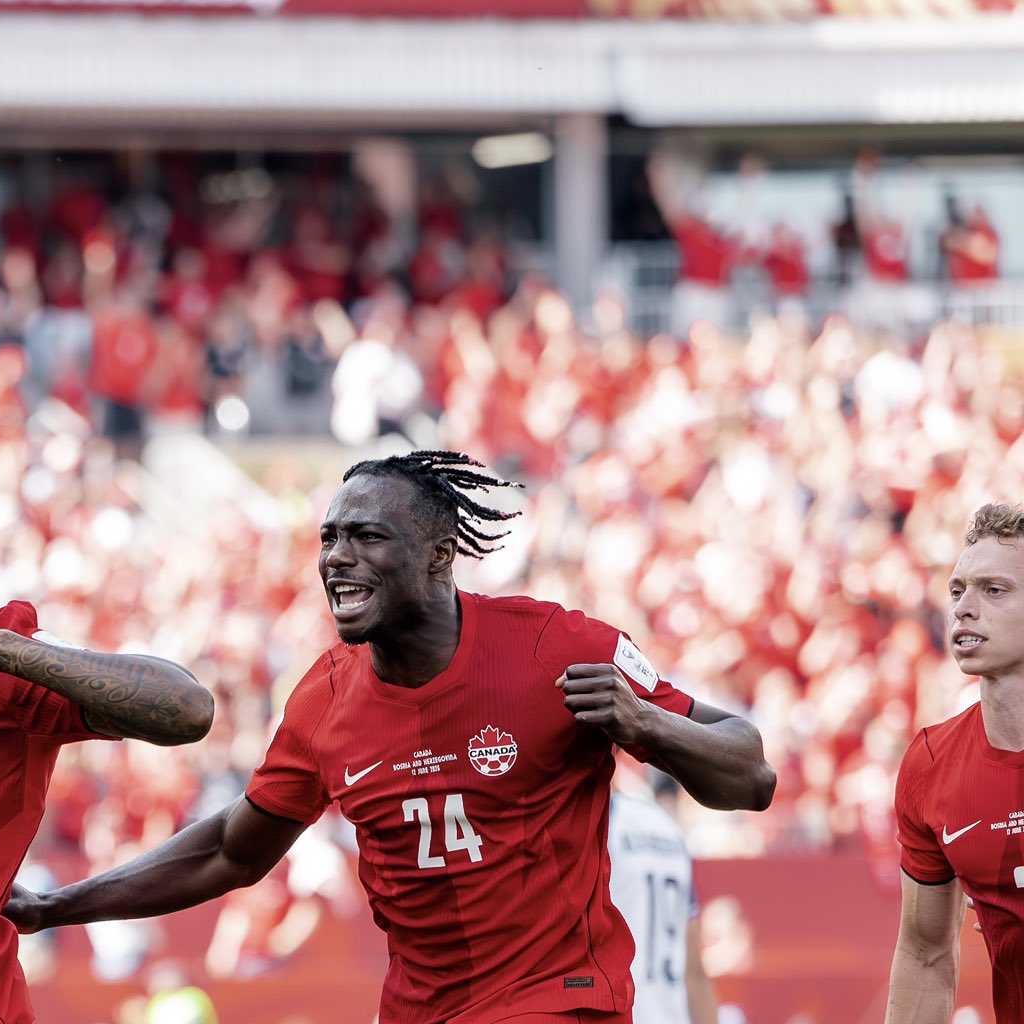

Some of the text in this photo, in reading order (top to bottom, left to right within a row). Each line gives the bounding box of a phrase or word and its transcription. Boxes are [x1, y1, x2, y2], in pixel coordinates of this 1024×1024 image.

[414, 749, 432, 758] CANADA
[469, 746, 516, 758] CANADA
[393, 762, 411, 771] BOSNIA
[423, 754, 457, 765] HERZEGOVINA
[401, 793, 484, 869] 24
